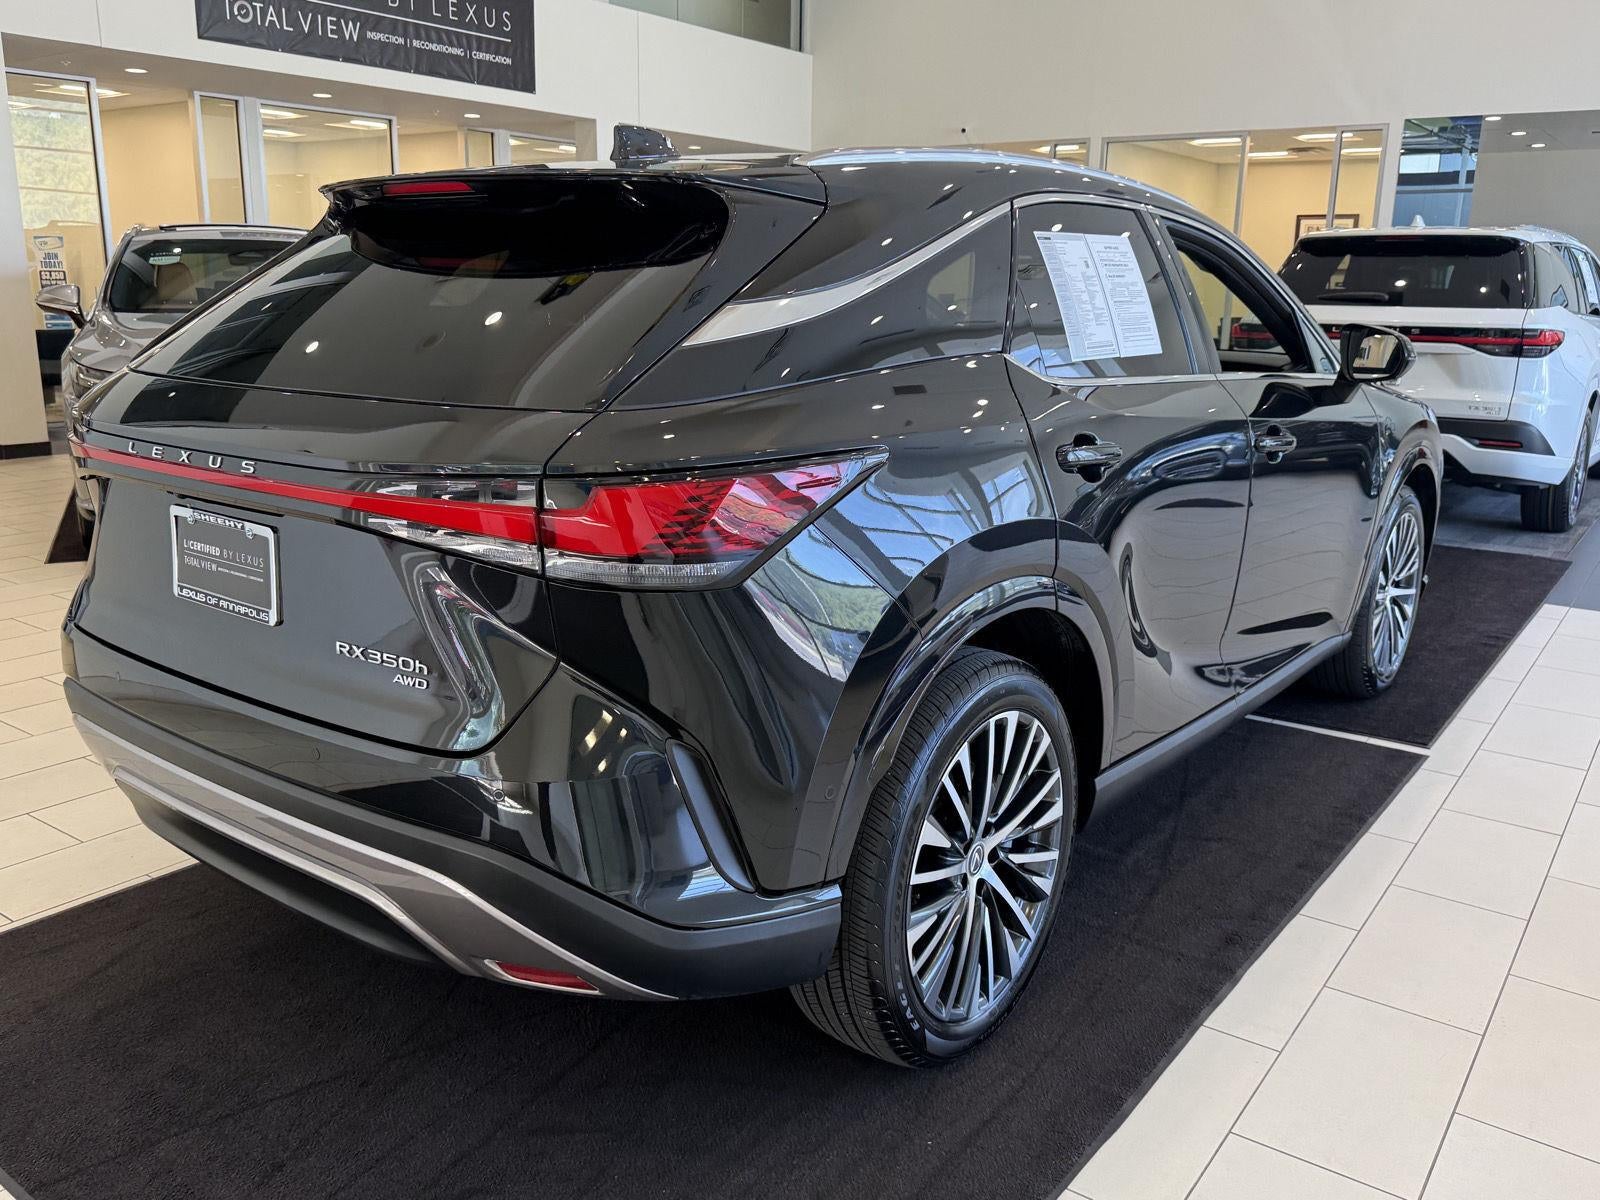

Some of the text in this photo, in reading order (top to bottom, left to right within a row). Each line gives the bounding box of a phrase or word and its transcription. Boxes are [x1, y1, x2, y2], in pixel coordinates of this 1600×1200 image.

[432, 0, 512, 32] LEXUS
[366, 31, 405, 45] INSPECTION
[412, 40, 465, 57] RECONDITIONING
[472, 51, 512, 66] CERTIFICATION
[40, 260, 63, 269] TODAY!
[43, 252, 58, 260] JOIN
[128, 441, 256, 474] LEXUS
[193, 512, 244, 529] SHEEHY
[223, 549, 233, 559] BY
[236, 552, 264, 568] LEXUS
[178, 587, 269, 621] LEXUS OF ANNAPOLIS
[393, 674, 428, 690] AWD
